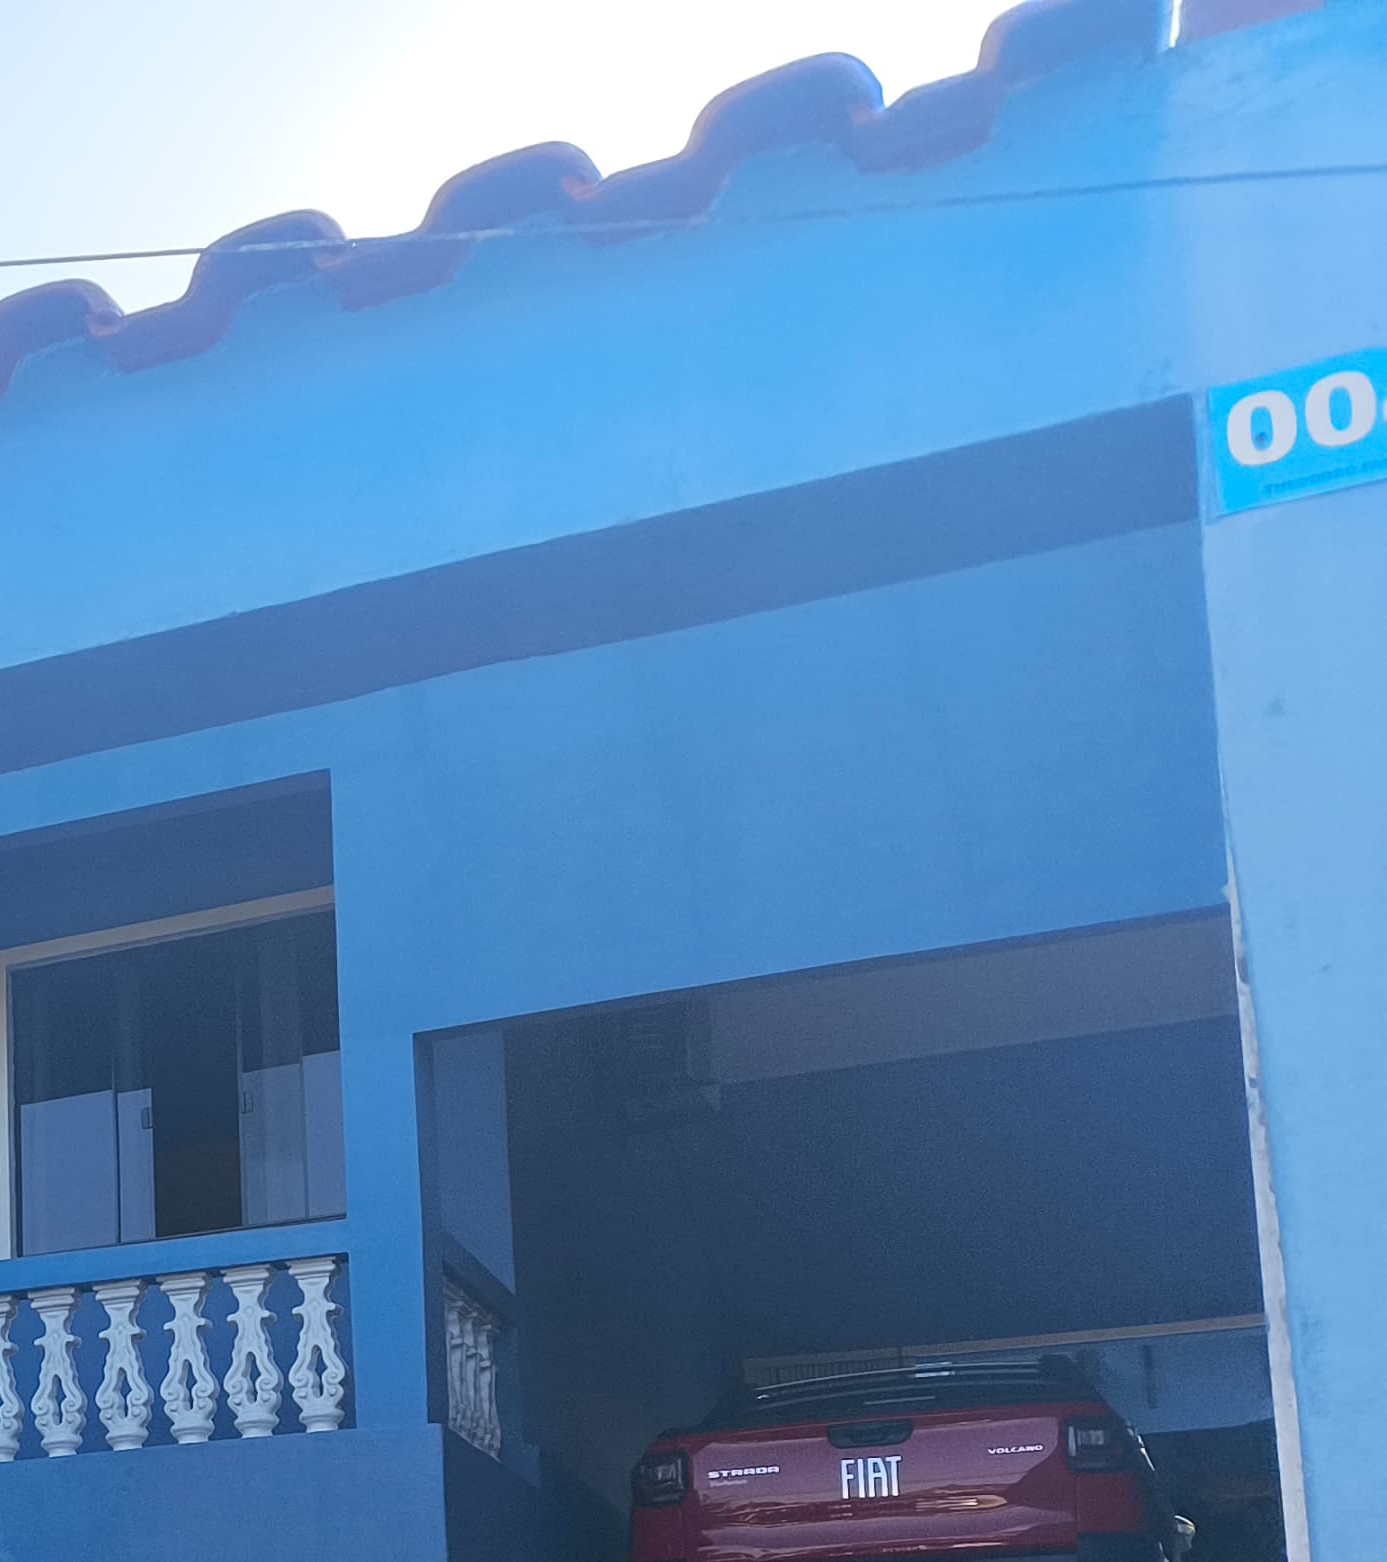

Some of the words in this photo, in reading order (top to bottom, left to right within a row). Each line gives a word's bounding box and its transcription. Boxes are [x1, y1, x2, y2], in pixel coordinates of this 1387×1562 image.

[1227, 371, 1387, 467] 00
[988, 1445, 1044, 1454] VOLCANO
[707, 1466, 780, 1479] STRADA
[841, 1456, 902, 1499] FIAT
